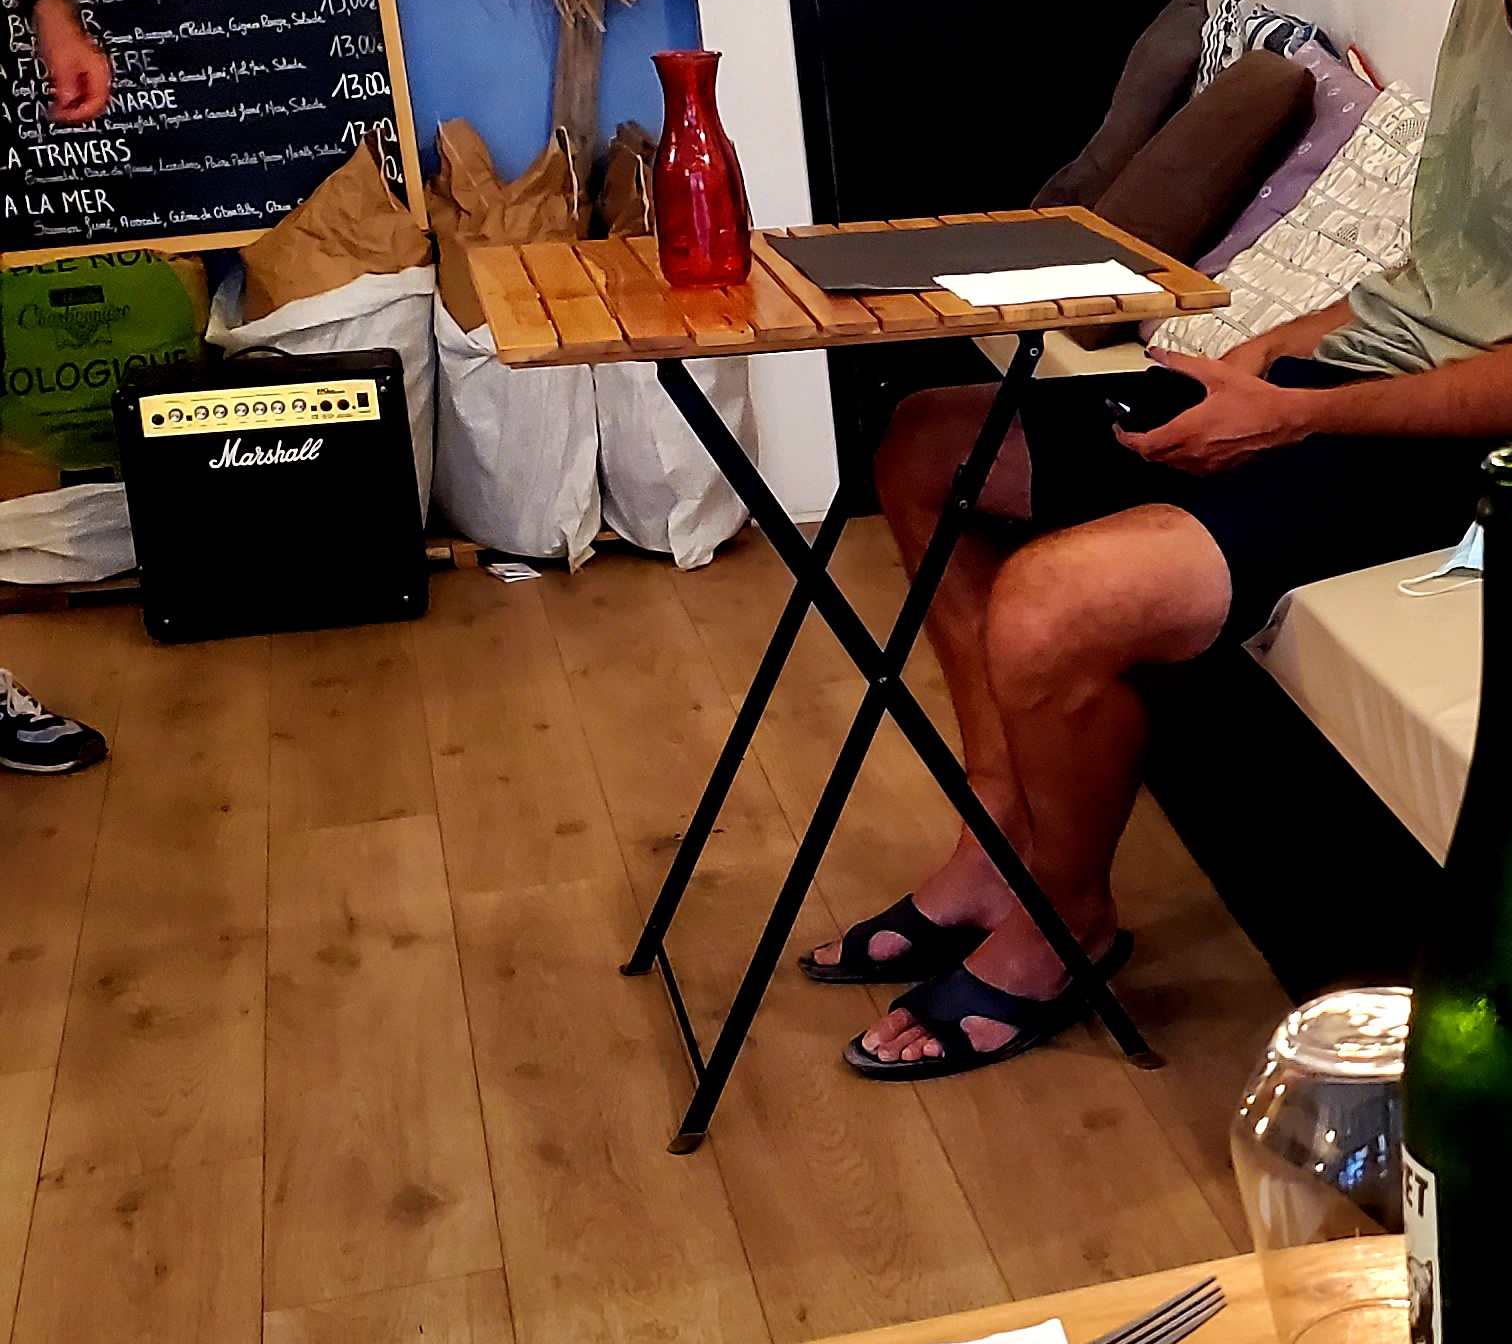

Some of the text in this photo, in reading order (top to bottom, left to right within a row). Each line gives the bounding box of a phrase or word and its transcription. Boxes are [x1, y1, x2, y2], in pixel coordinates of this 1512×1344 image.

[28, 138, 132, 168] TRAVERS
[5, 188, 115, 219] A LA MER
[209, 437, 324, 469] Marshall
